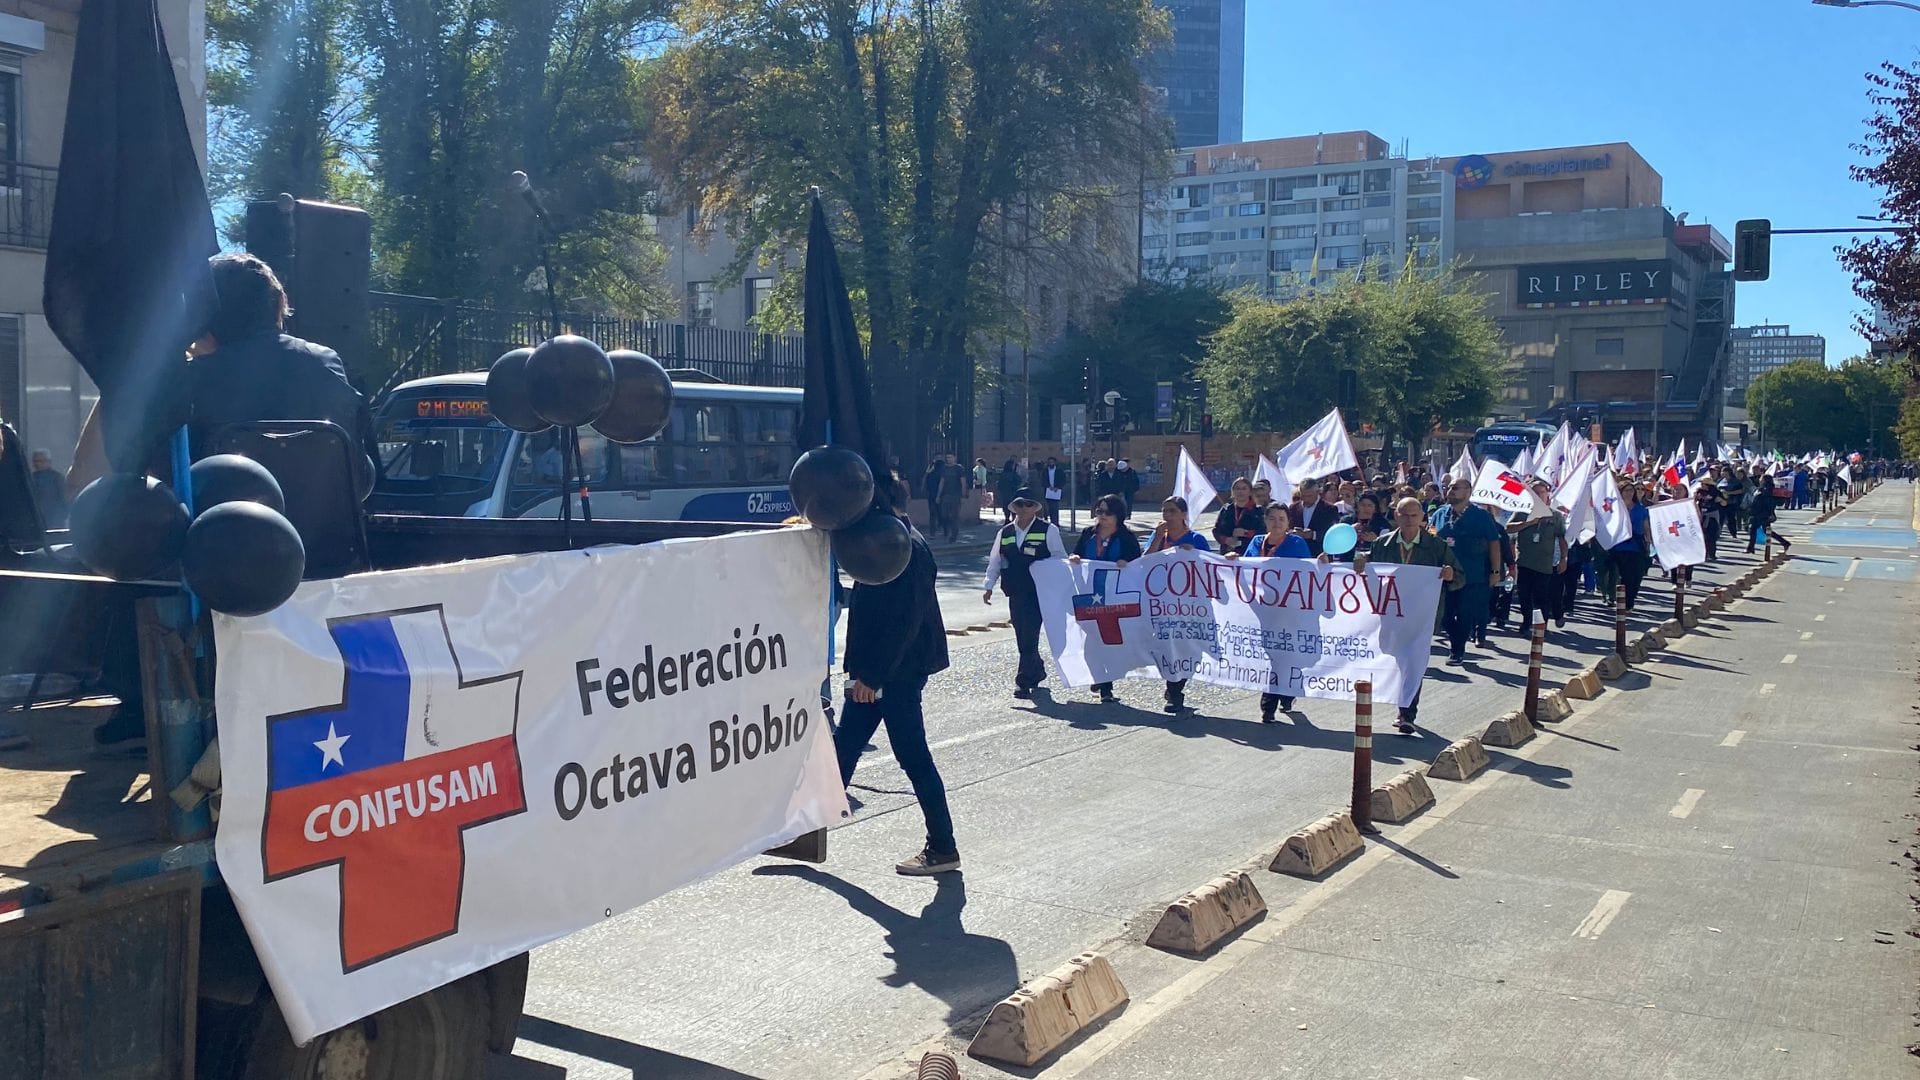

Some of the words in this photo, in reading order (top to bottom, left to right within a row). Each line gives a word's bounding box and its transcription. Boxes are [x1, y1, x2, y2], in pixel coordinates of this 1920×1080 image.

[1504, 153, 1612, 176] cineplanet
[1528, 270, 1660, 294] RIPLEY
[748, 493, 764, 514] 62
[764, 493, 772, 502] MI
[764, 503, 791, 513] EXPRESO
[1145, 560, 1335, 612] CONFUSAM
[1185, 628, 1215, 642] Salud
[1278, 628, 1292, 641] de
[1297, 630, 1368, 647] Funcionarios
[576, 624, 788, 717] Federación
[1219, 657, 1278, 687] Primaria
[554, 742, 697, 822] Octava
[708, 698, 808, 773] Biobío
[303, 761, 499, 843] CONFUSAM
